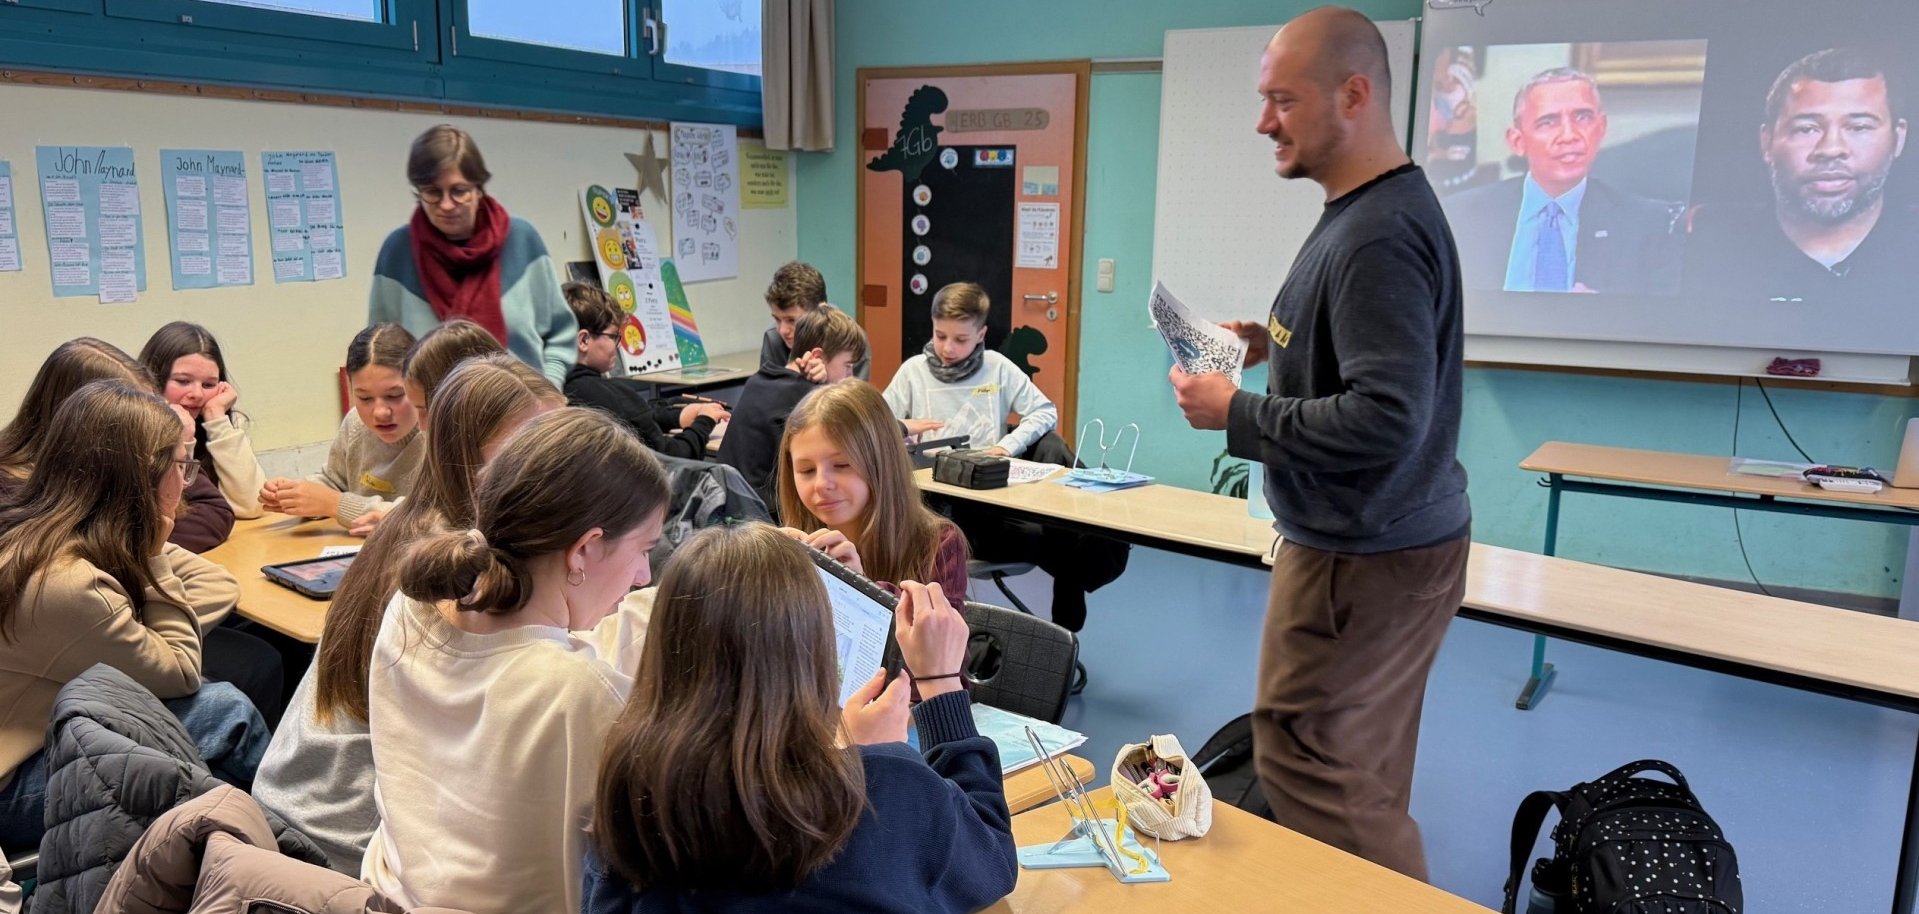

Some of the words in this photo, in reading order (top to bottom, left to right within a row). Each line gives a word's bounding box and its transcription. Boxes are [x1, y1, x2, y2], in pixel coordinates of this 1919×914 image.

[993, 112, 1012, 130] GB
[1024, 111, 1043, 128] 25
[896, 125, 933, 160] 7Gb
[54, 147, 92, 174] John
[176, 156, 203, 172] John
